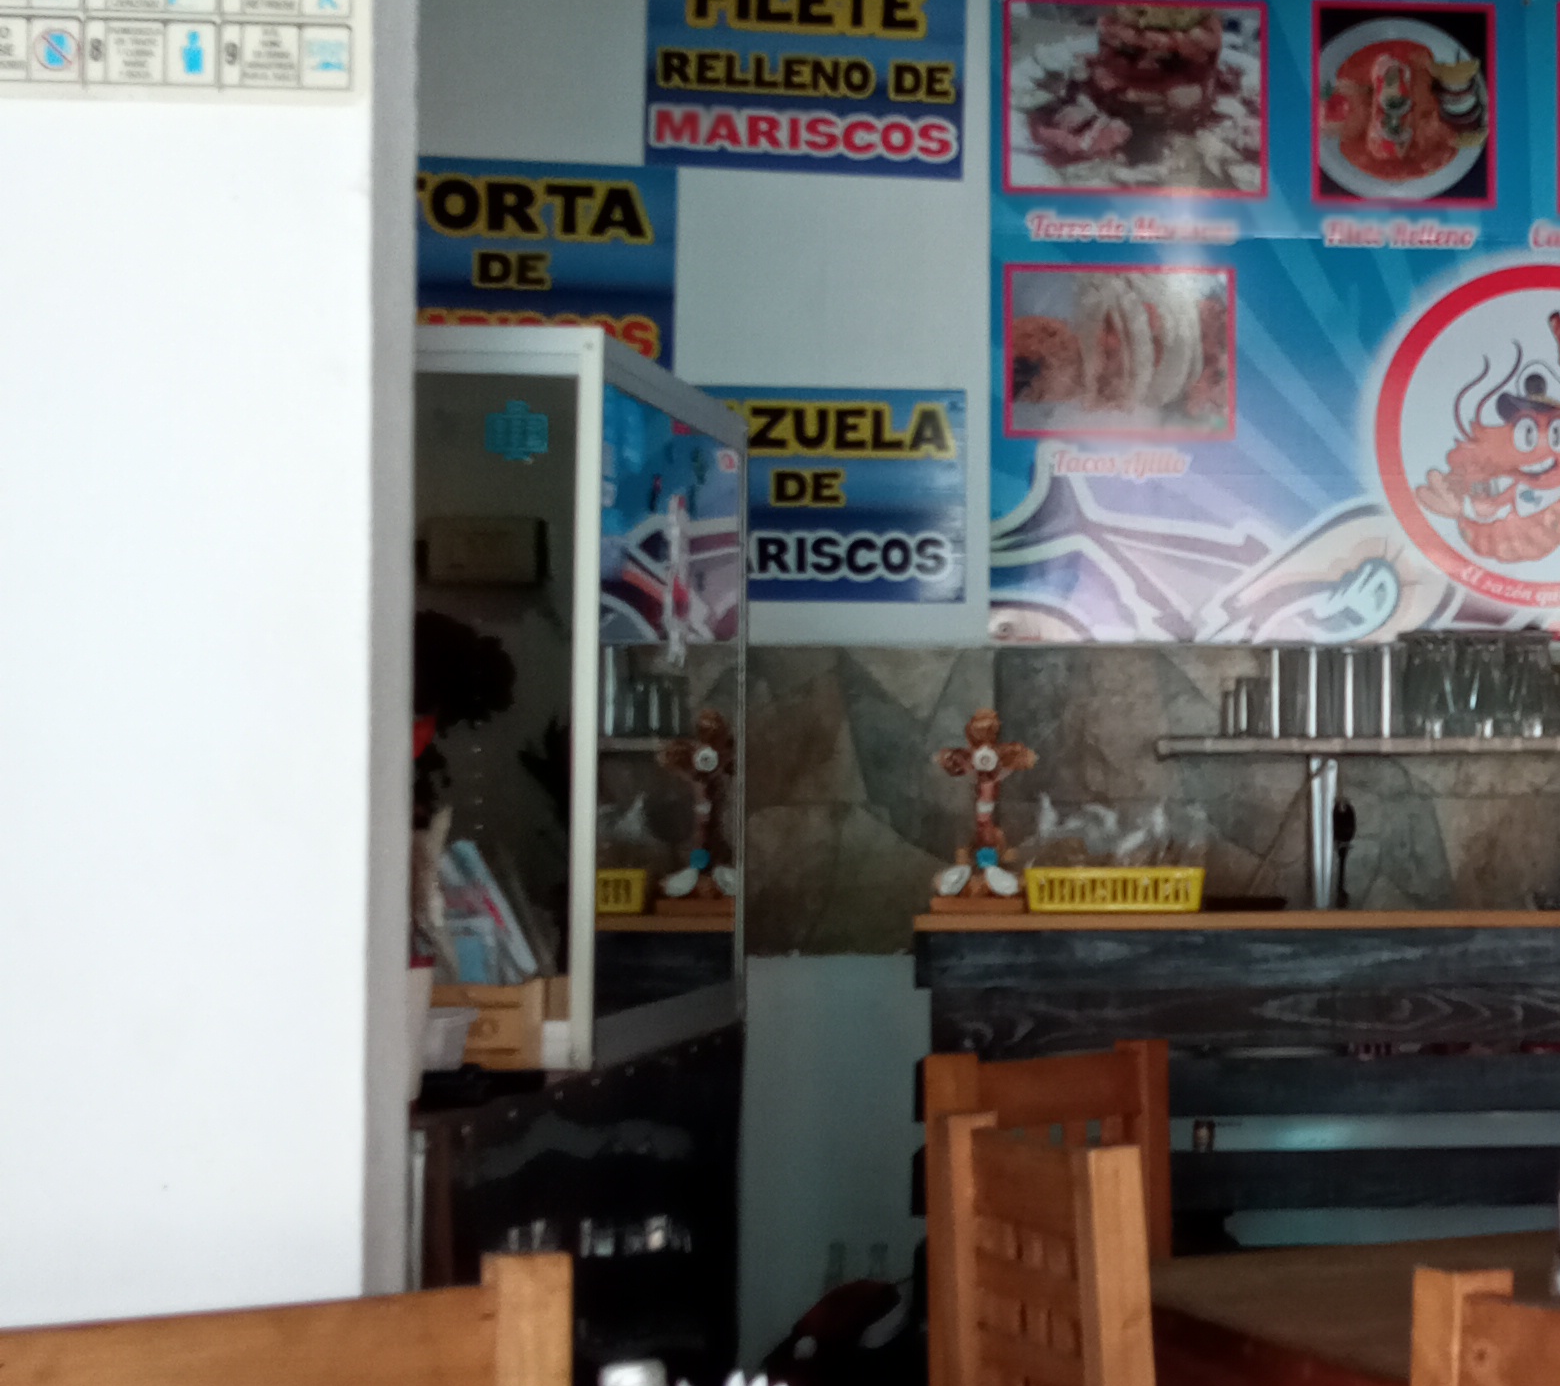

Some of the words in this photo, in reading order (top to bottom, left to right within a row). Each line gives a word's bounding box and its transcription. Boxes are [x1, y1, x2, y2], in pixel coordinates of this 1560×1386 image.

[658, 49, 873, 97] RELLENO
[890, 61, 954, 100] DE
[653, 108, 955, 159] MARISCOS
[476, 251, 549, 288] DE
[748, 406, 951, 452] ZUELA
[773, 470, 844, 505] DE
[747, 535, 949, 576] RISCOS
